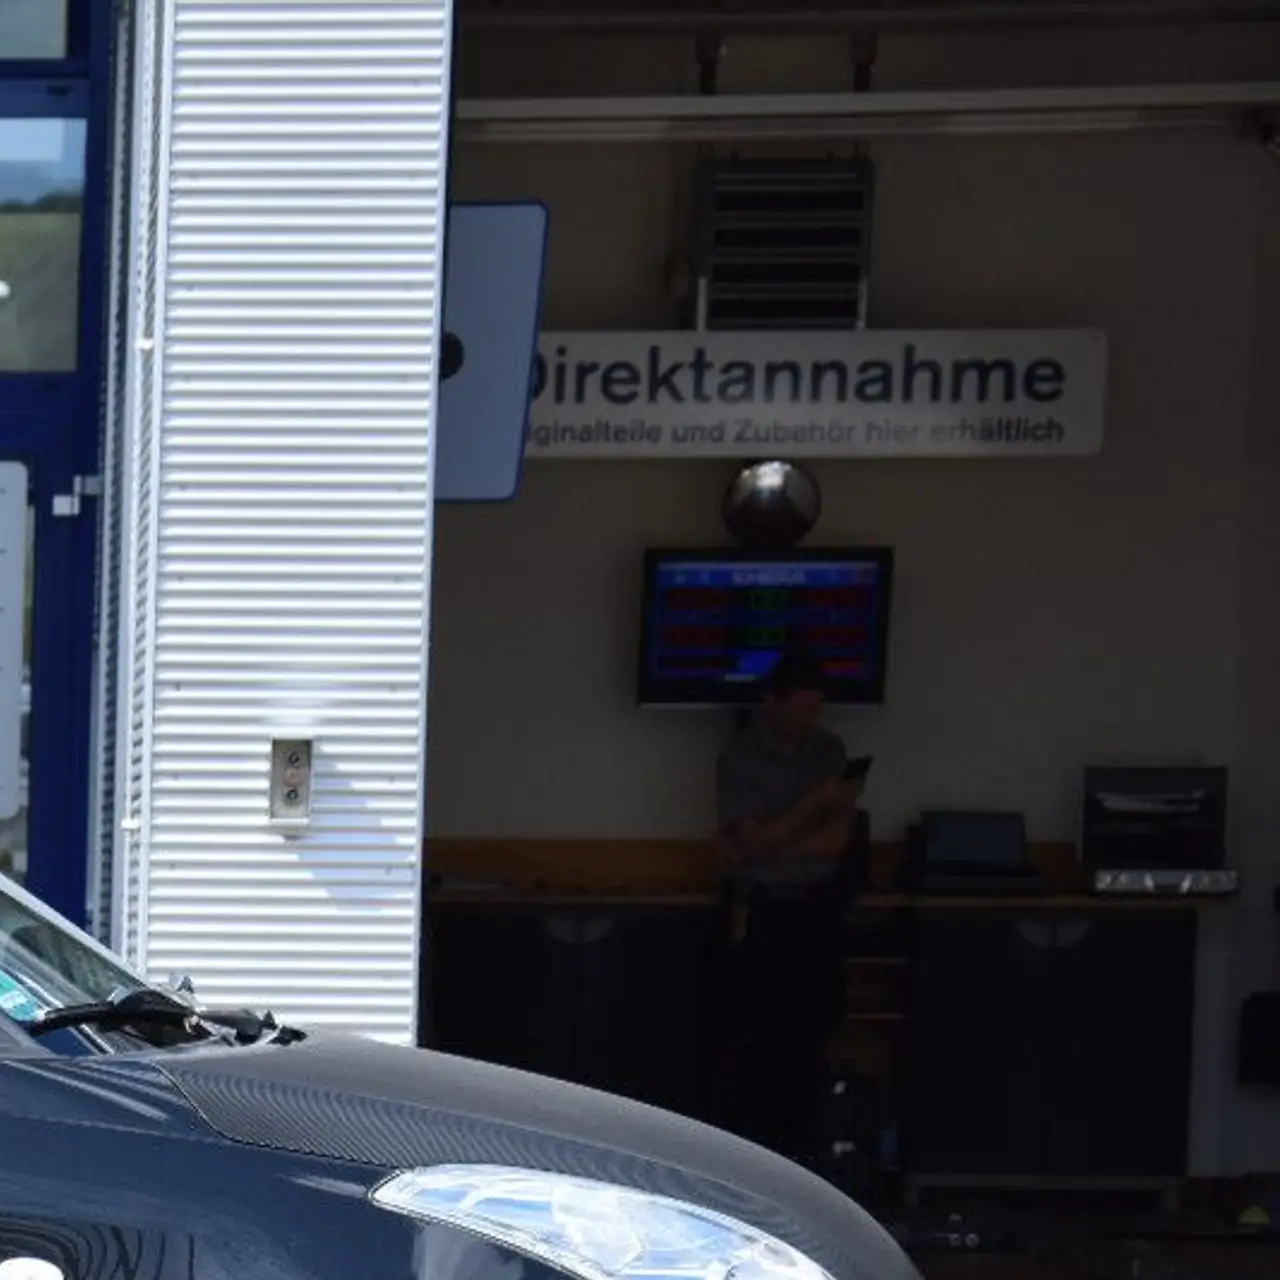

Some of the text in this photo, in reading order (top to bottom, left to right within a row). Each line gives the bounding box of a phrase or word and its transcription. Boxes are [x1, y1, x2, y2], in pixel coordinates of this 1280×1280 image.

[671, 419, 726, 444] und
[733, 417, 854, 444] Zubehör
[865, 416, 920, 443] hier
[930, 415, 1066, 443] erhältlich
